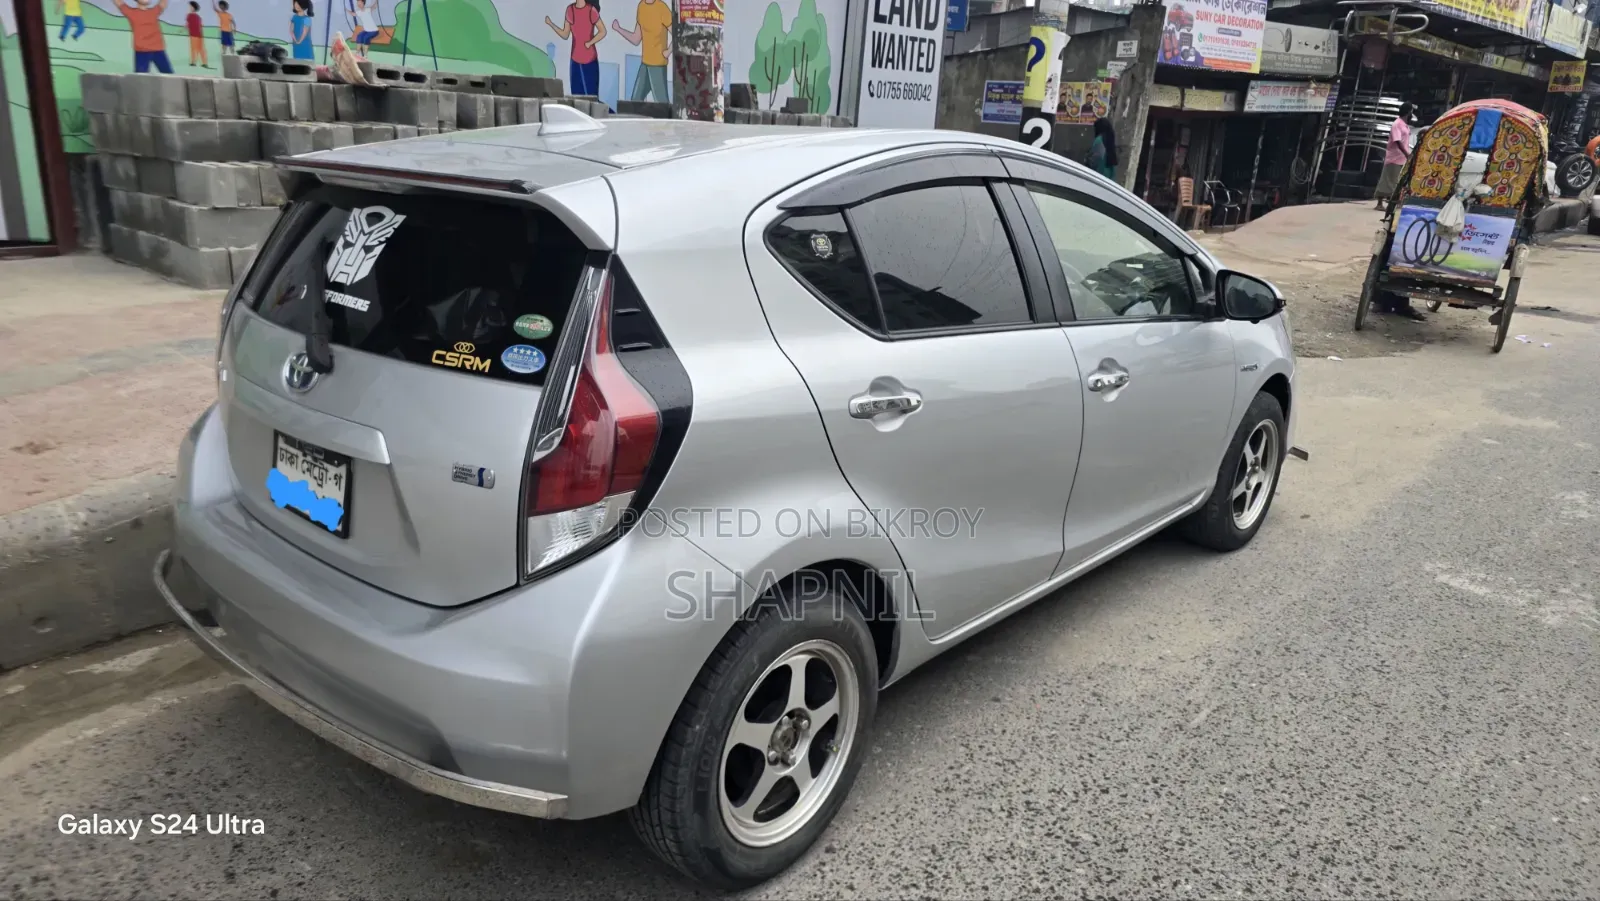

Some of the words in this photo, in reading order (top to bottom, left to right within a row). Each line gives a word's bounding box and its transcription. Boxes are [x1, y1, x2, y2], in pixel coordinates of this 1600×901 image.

[1195, 10, 1213, 23] SUNY
[1213, 14, 1226, 25] CAR
[1227, 15, 1264, 30] DECORATION
[871, 30, 936, 73] WANTED
[876, 80, 902, 100] 01755
[903, 82, 932, 101] 660042
[431, 350, 491, 373] CSRM
[279, 447, 299, 470] ঢাকা
